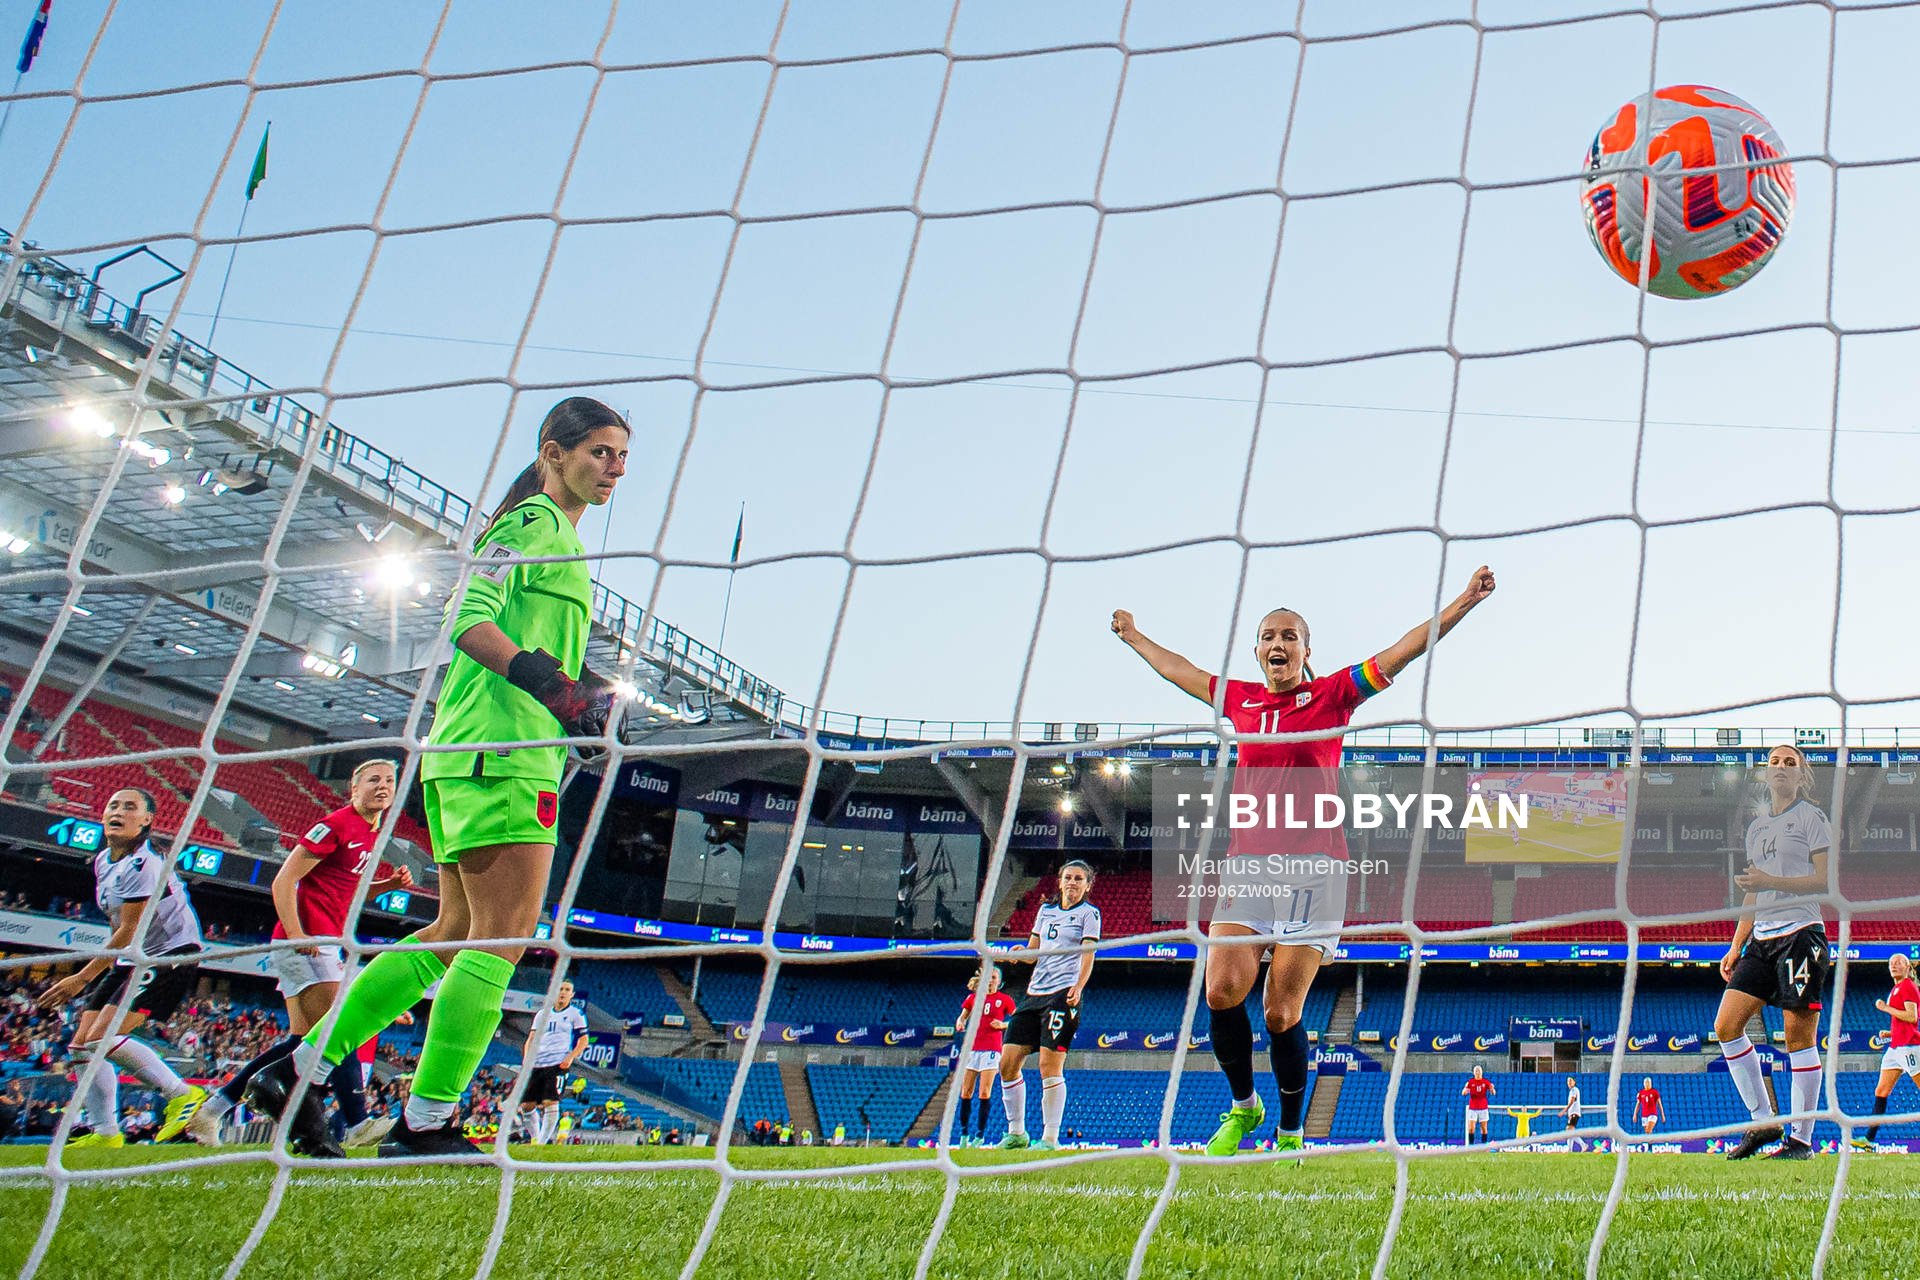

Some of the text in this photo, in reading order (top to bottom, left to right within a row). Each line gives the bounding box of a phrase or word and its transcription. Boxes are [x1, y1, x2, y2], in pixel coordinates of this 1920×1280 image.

[1259, 709, 1280, 734] 11
[630, 769, 669, 793] bama
[845, 801, 893, 820] bama
[920, 806, 967, 823] bama
[73, 827, 96, 845] 5G
[1013, 820, 1057, 836] bama
[1763, 835, 1777, 860] 14
[196, 855, 217, 869] 5G
[390, 895, 405, 909] 5G
[1289, 889, 1313, 923] 11
[1047, 923, 1060, 940] 15
[1147, 944, 1178, 957] bama
[1489, 946, 1519, 959] bama
[1659, 946, 1690, 959] bama
[1785, 956, 1811, 985] 14
[1048, 1010, 1066, 1030] 15
[1529, 1025, 1563, 1039] bama
[577, 1044, 615, 1064] ama
[1315, 1050, 1354, 1064] bama
[1905, 1053, 1917, 1068] 18
